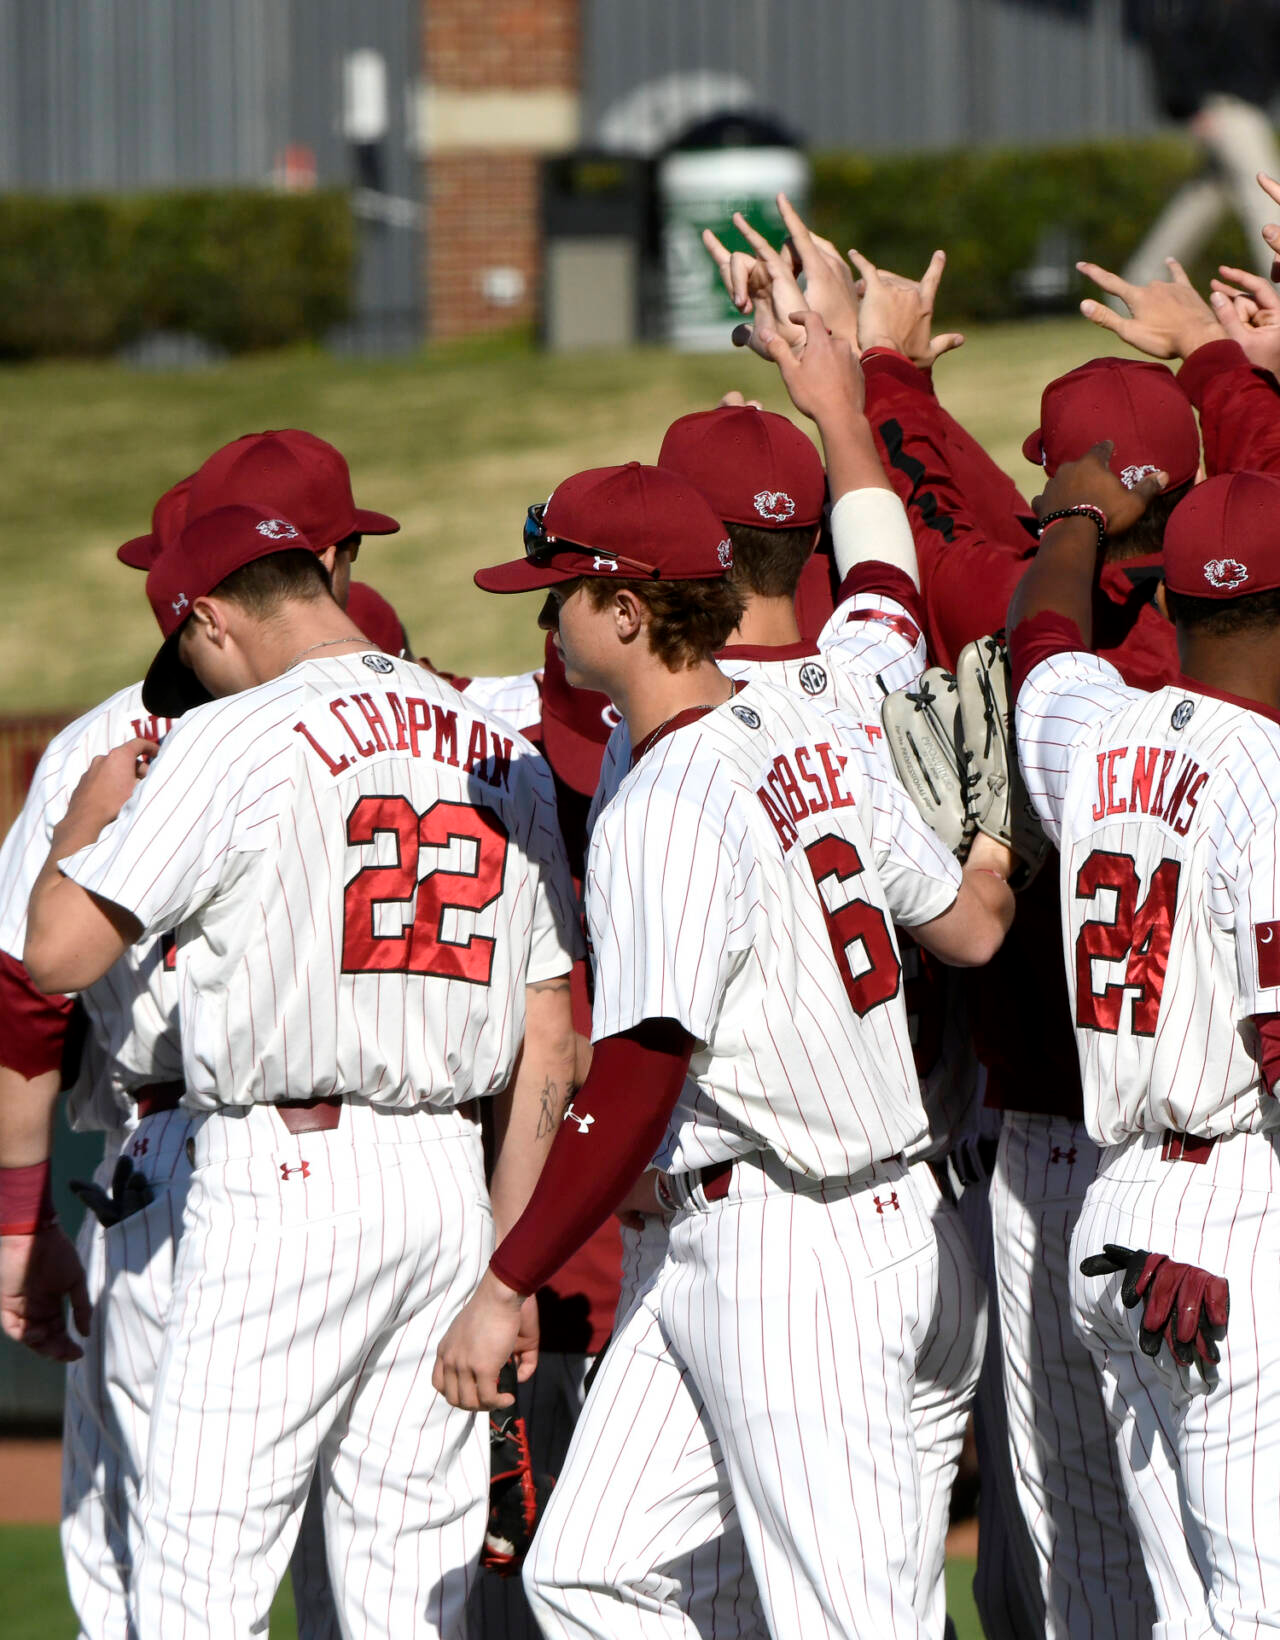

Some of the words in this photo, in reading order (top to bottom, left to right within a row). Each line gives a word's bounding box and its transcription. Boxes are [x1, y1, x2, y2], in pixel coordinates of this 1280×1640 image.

[292, 691, 514, 793] L.CHAPMAN
[799, 662, 827, 696] SEC
[341, 794, 510, 987] 22
[803, 832, 903, 1019] 6
[1075, 849, 1182, 1038] 24
